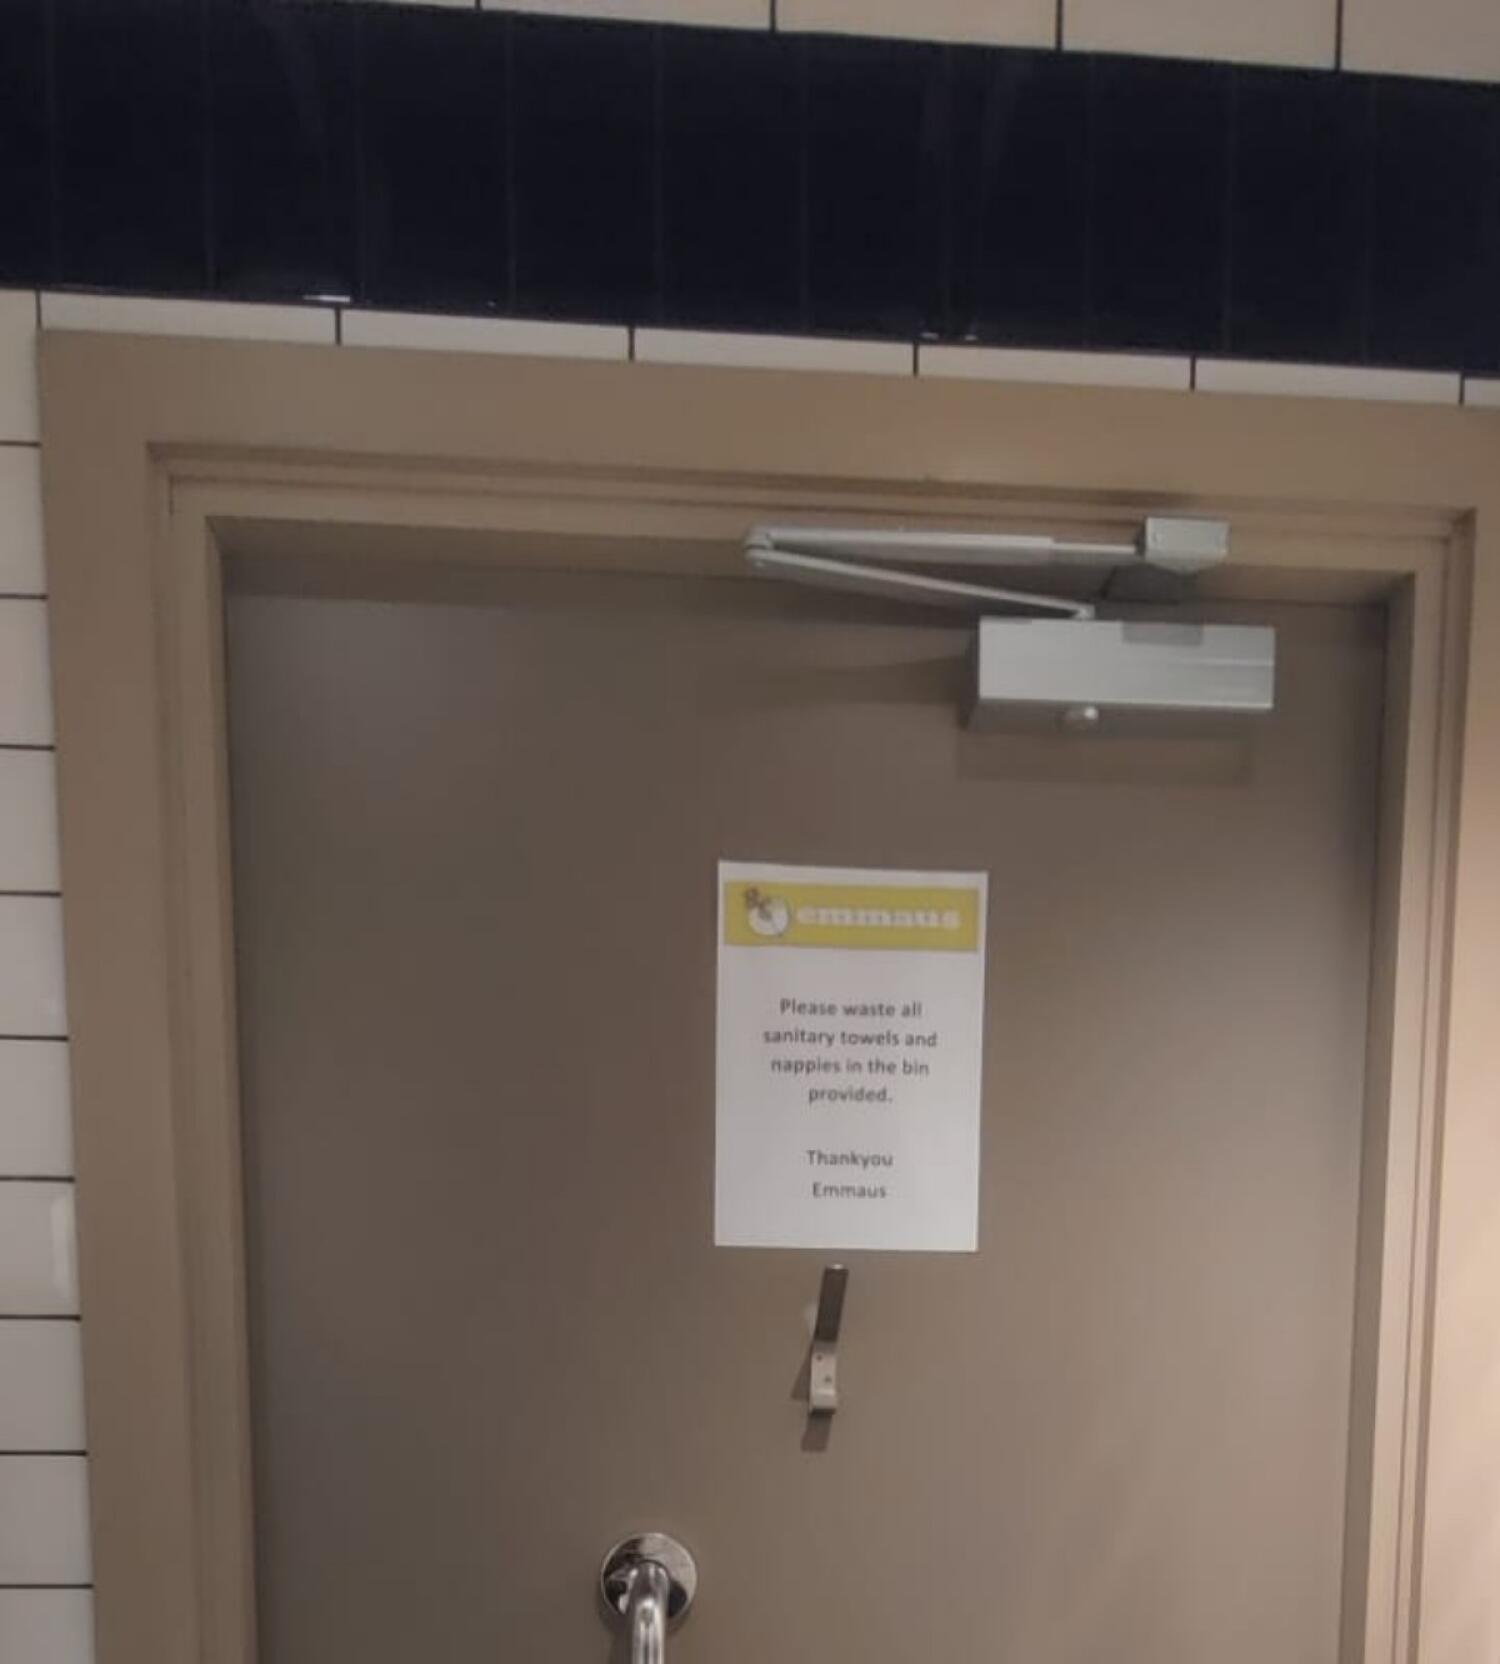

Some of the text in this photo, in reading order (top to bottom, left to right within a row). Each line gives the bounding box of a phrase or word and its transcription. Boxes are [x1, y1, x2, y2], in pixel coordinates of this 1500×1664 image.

[796, 905, 961, 929] emmaus
[779, 998, 922, 1018] Please waste all
[763, 1028, 937, 1048] sanitary towels and
[770, 1057, 929, 1075] nappies in the bin
[808, 1086, 893, 1105] provided.
[806, 1149, 893, 1169] Thankyou
[812, 1182, 886, 1199] Emmaus
